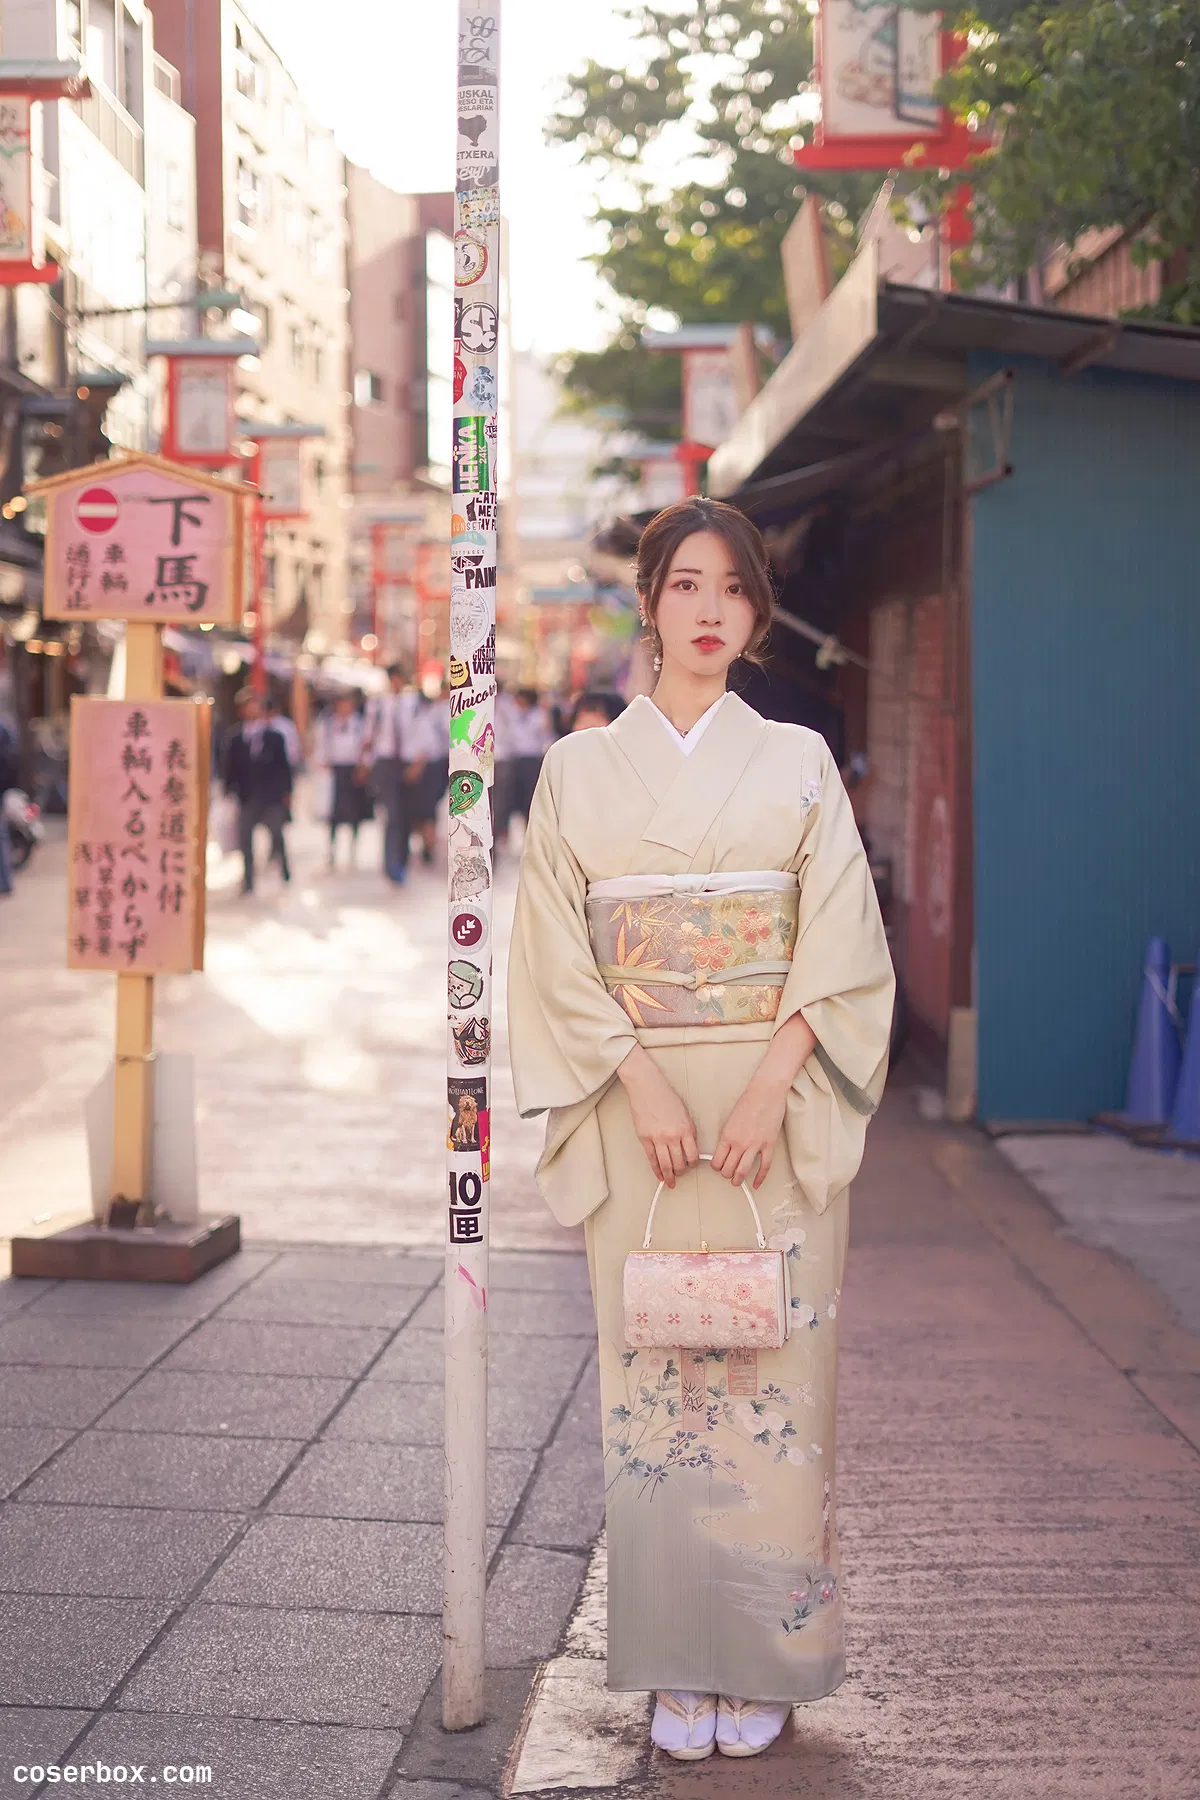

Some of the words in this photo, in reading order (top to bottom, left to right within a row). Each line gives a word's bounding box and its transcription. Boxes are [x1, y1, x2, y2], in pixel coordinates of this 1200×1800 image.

[479, 445, 487, 464] 24K
[478, 505, 492, 517] ME
[144, 495, 210, 612] 下馬
[449, 1171, 482, 1207] 10
